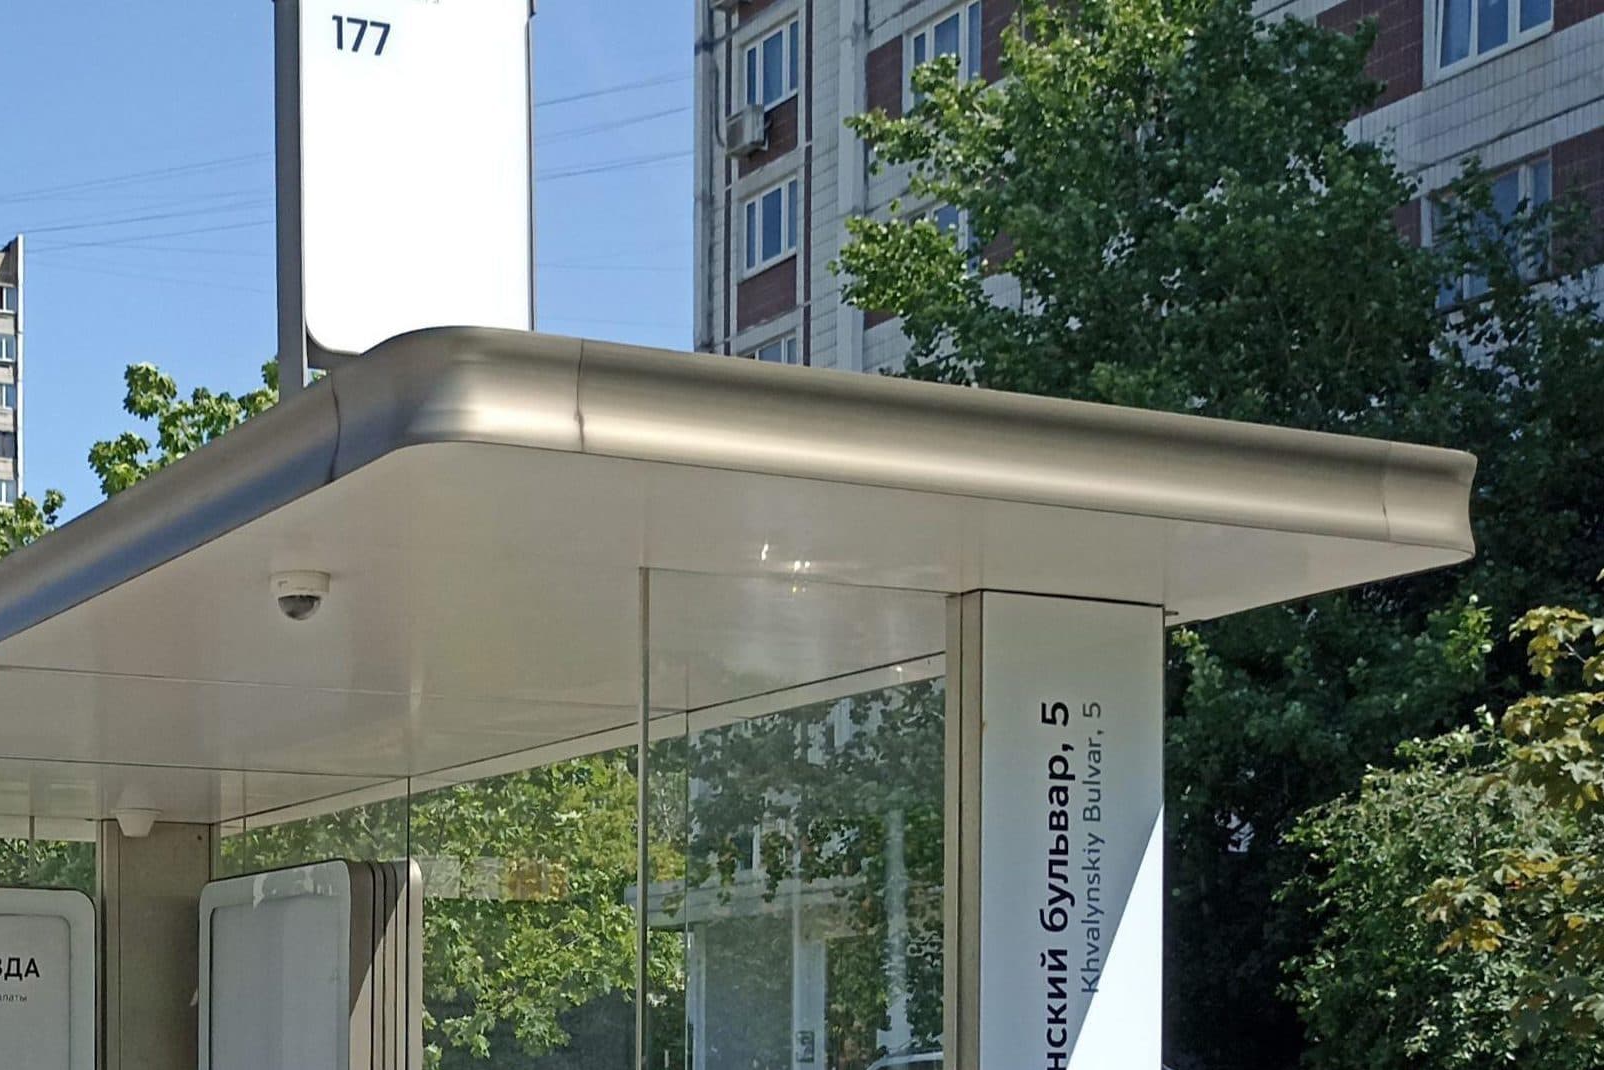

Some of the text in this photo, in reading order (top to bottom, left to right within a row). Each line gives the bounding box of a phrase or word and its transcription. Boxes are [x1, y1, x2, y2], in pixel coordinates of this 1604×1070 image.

[332, 14, 391, 56] 177
[1041, 702, 1069, 727] 5
[1039, 743, 1076, 933] бульвар,
[1080, 702, 1106, 993] Khvalynskiy Bulvar, 5
